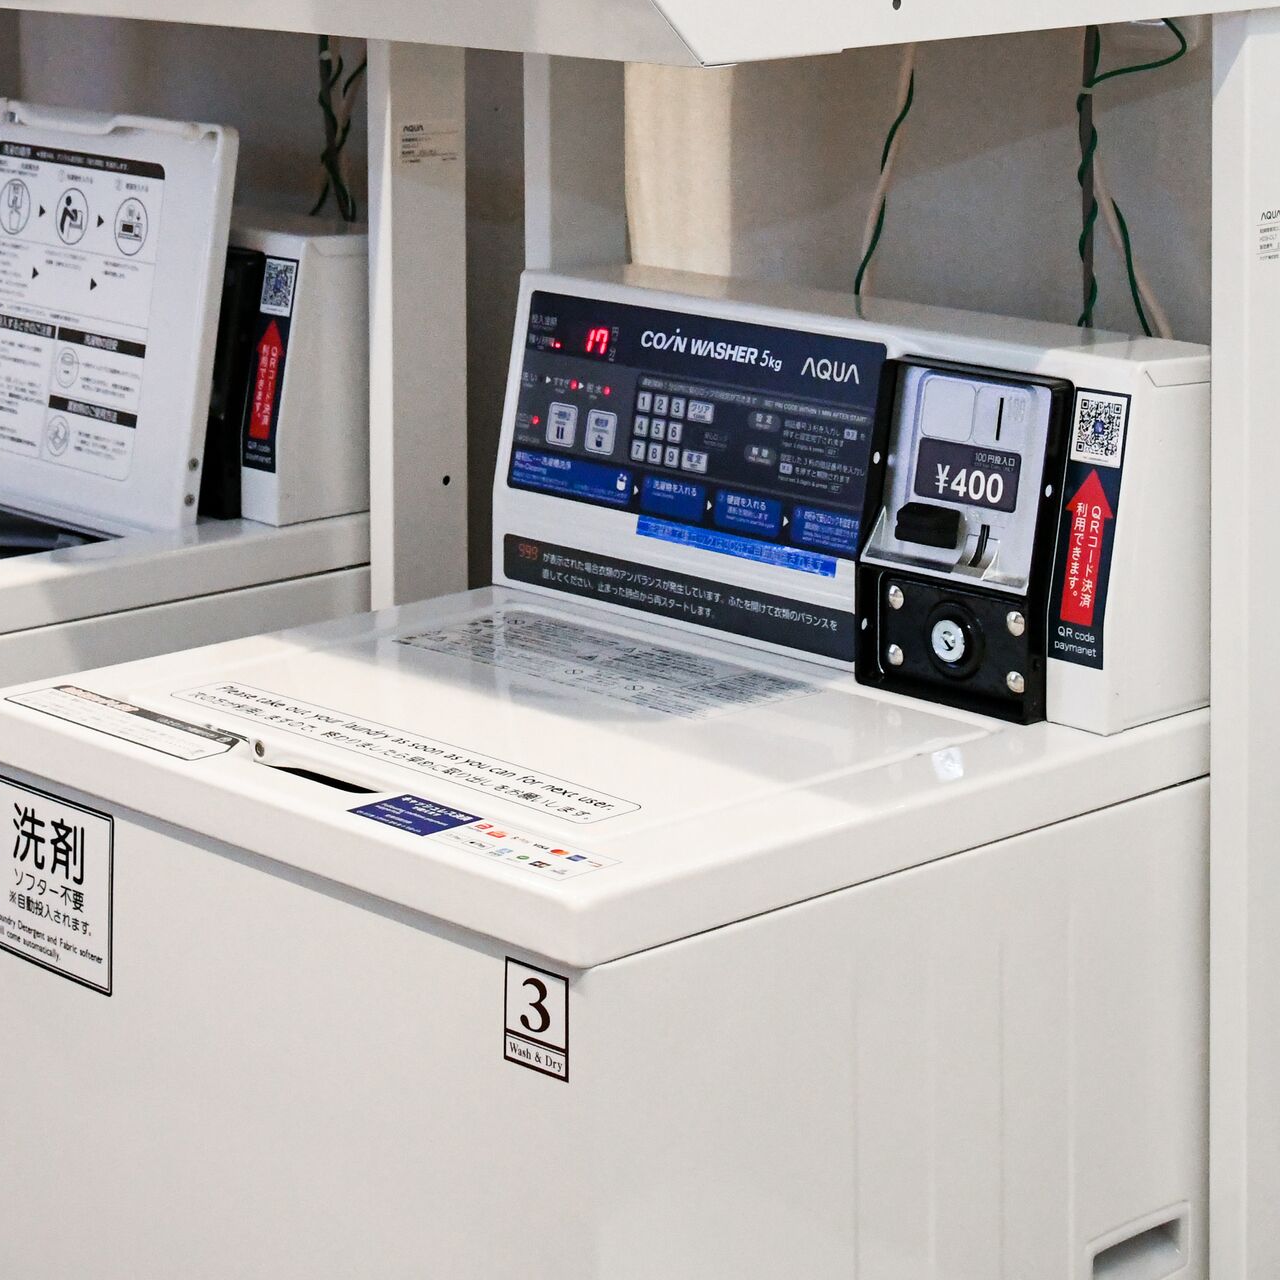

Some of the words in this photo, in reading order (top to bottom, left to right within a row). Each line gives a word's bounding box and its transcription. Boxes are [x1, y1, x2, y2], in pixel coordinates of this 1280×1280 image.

[690, 339, 757, 366] WASHER
[760, 349, 782, 371] 5kg
[801, 356, 860, 384] AQUA
[935, 463, 1003, 504] ¥400
[1068, 502, 1089, 597] 利用できます。
[1079, 505, 1102, 609] QRコード決済
[1054, 641, 1097, 658] paymanet
[1058, 626, 1073, 638] QR
[1074, 631, 1095, 644] code
[13, 802, 85, 886] 洗剤
[14, 868, 85, 914] ソフター不要
[520, 978, 550, 1033] 3
[509, 1041, 531, 1060] Wash
[534, 1051, 541, 1064] &
[545, 1055, 562, 1072] Dry
